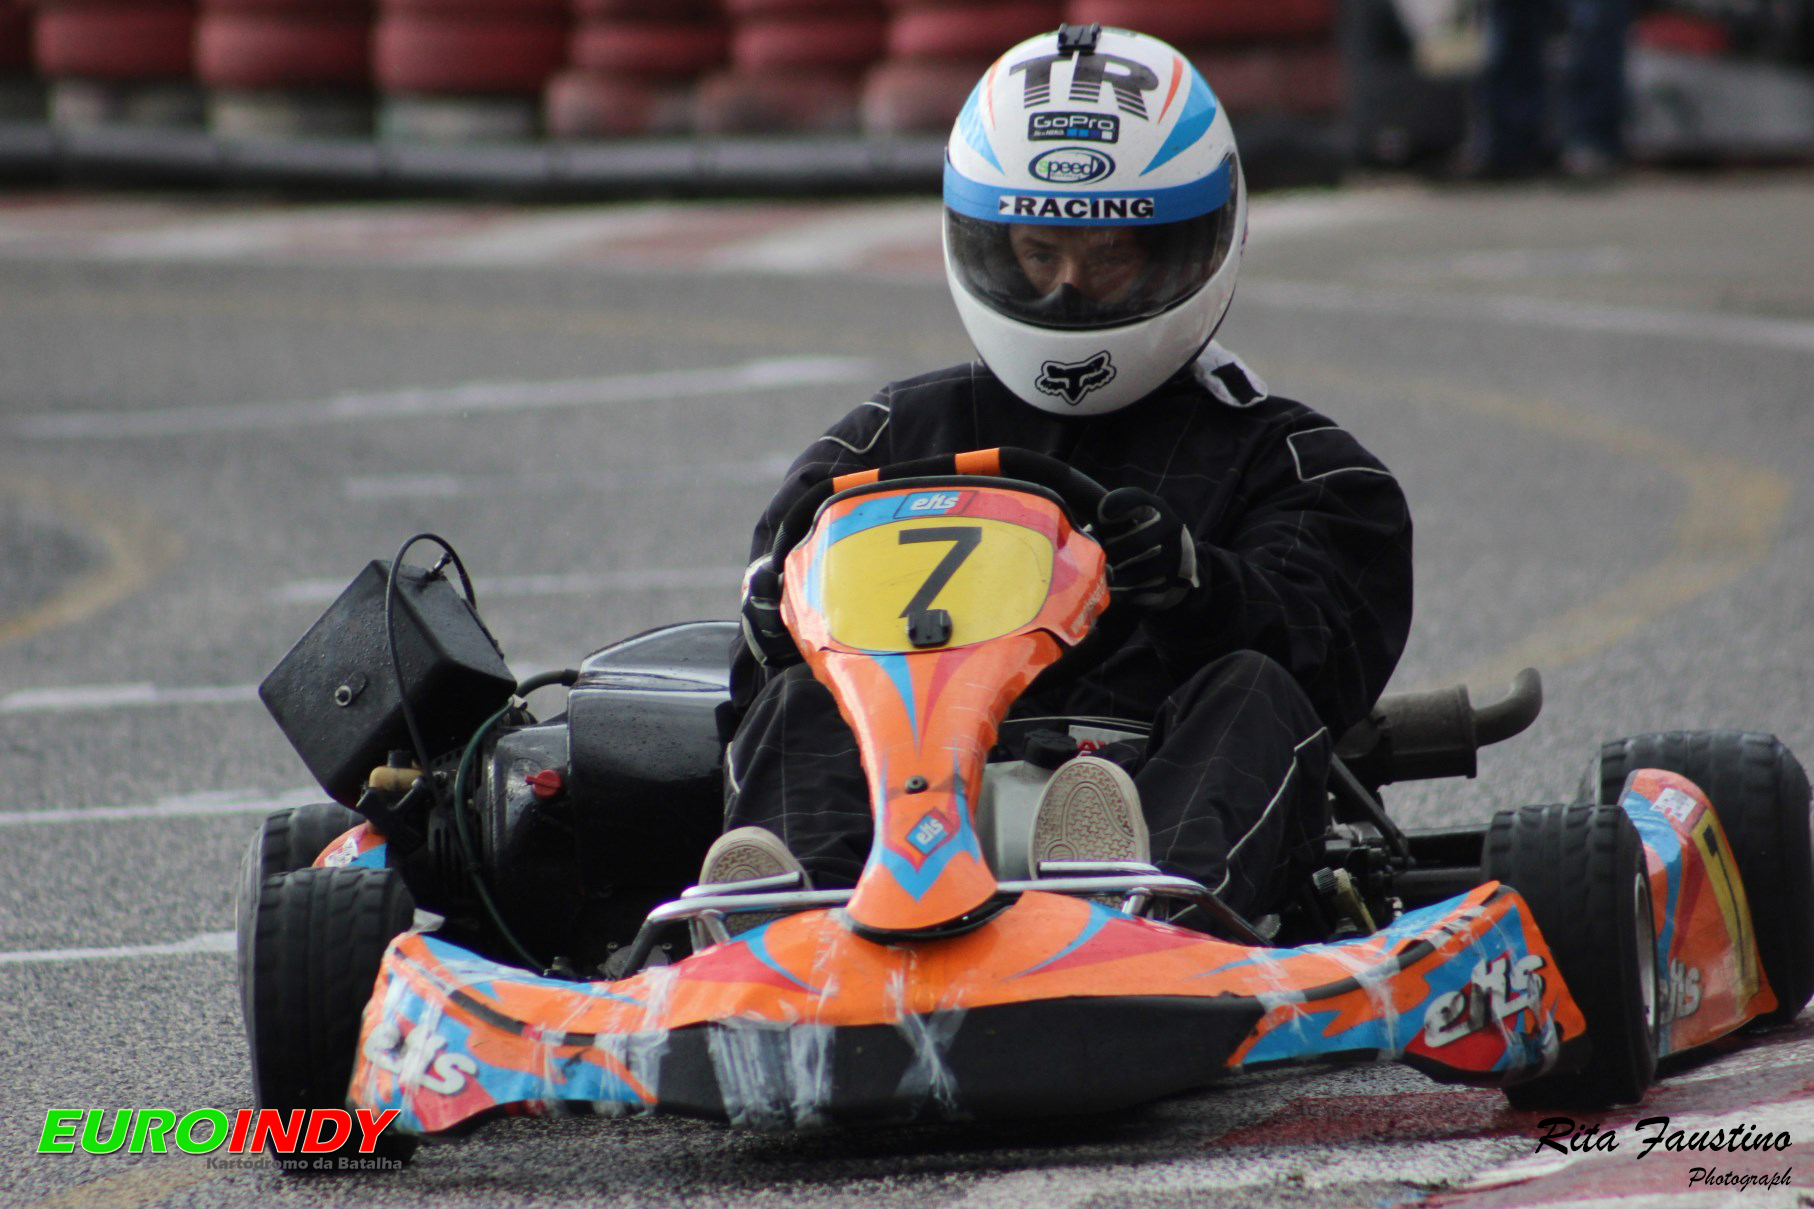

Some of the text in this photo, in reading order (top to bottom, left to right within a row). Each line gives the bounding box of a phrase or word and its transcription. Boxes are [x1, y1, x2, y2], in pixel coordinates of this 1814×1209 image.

[1009, 51, 1159, 121] TR
[1033, 115, 1115, 130] GoPro
[1014, 196, 1155, 218] RACING
[898, 526, 982, 619] 7
